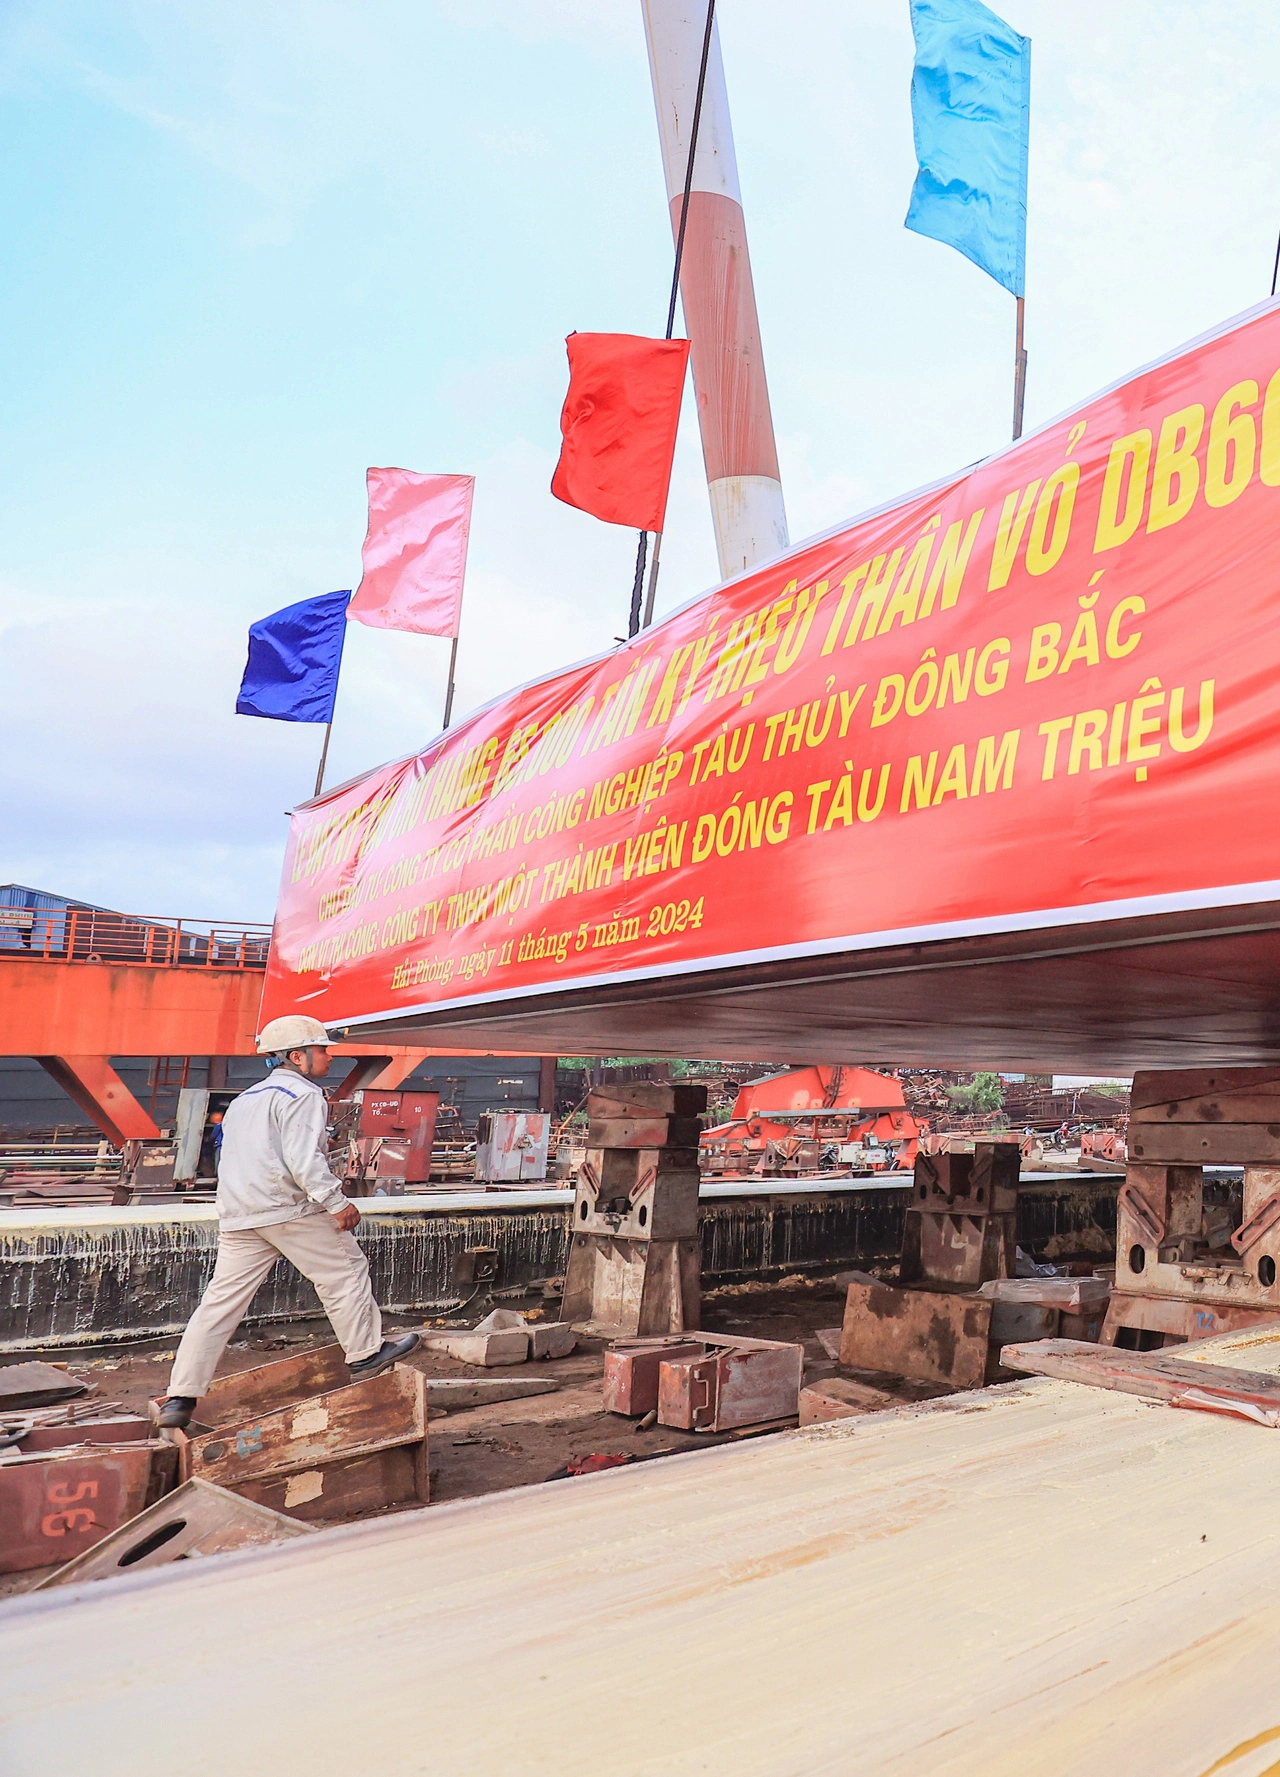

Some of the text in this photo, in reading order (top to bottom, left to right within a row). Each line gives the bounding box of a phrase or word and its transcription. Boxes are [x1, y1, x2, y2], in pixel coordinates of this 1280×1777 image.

[422, 737, 499, 825] HÀNG
[581, 641, 662, 758] TẤN
[645, 614, 722, 729] KÝ
[702, 577, 829, 708] HIỆU
[820, 507, 987, 658] THÂN
[987, 420, 1088, 593] VỎ
[328, 932, 346, 966] THI
[345, 919, 380, 961] CÔNG:
[381, 904, 420, 950] CÔNG
[422, 899, 445, 938] TY
[446, 883, 493, 932] TNHH
[491, 862, 540, 926] MỘT
[540, 841, 619, 904] THÀNH
[622, 815, 688, 882] VIÊN
[691, 791, 794, 864] ĐÓNG
[805, 760, 892, 835] TÀU
[899, 729, 1020, 814] NAM
[1037, 676, 1215, 783] TRIỆU
[383, 853, 421, 897] CÔNG
[421, 843, 447, 881] TY
[467, 802, 525, 865] PHẦN
[523, 790, 586, 845] CÔNG
[585, 746, 684, 822] NGHIỆP
[688, 721, 756, 787] TÀU
[762, 675, 867, 762] THỦY
[870, 637, 1010, 729] ĐÔNG
[1025, 569, 1146, 684] BẮC
[390, 896, 705, 990] Hải Phòng, ngày 11 tháng 5 năm 2024
[1196, 1312, 1215, 1331] T2
[42, 1480, 99, 1537] 56
